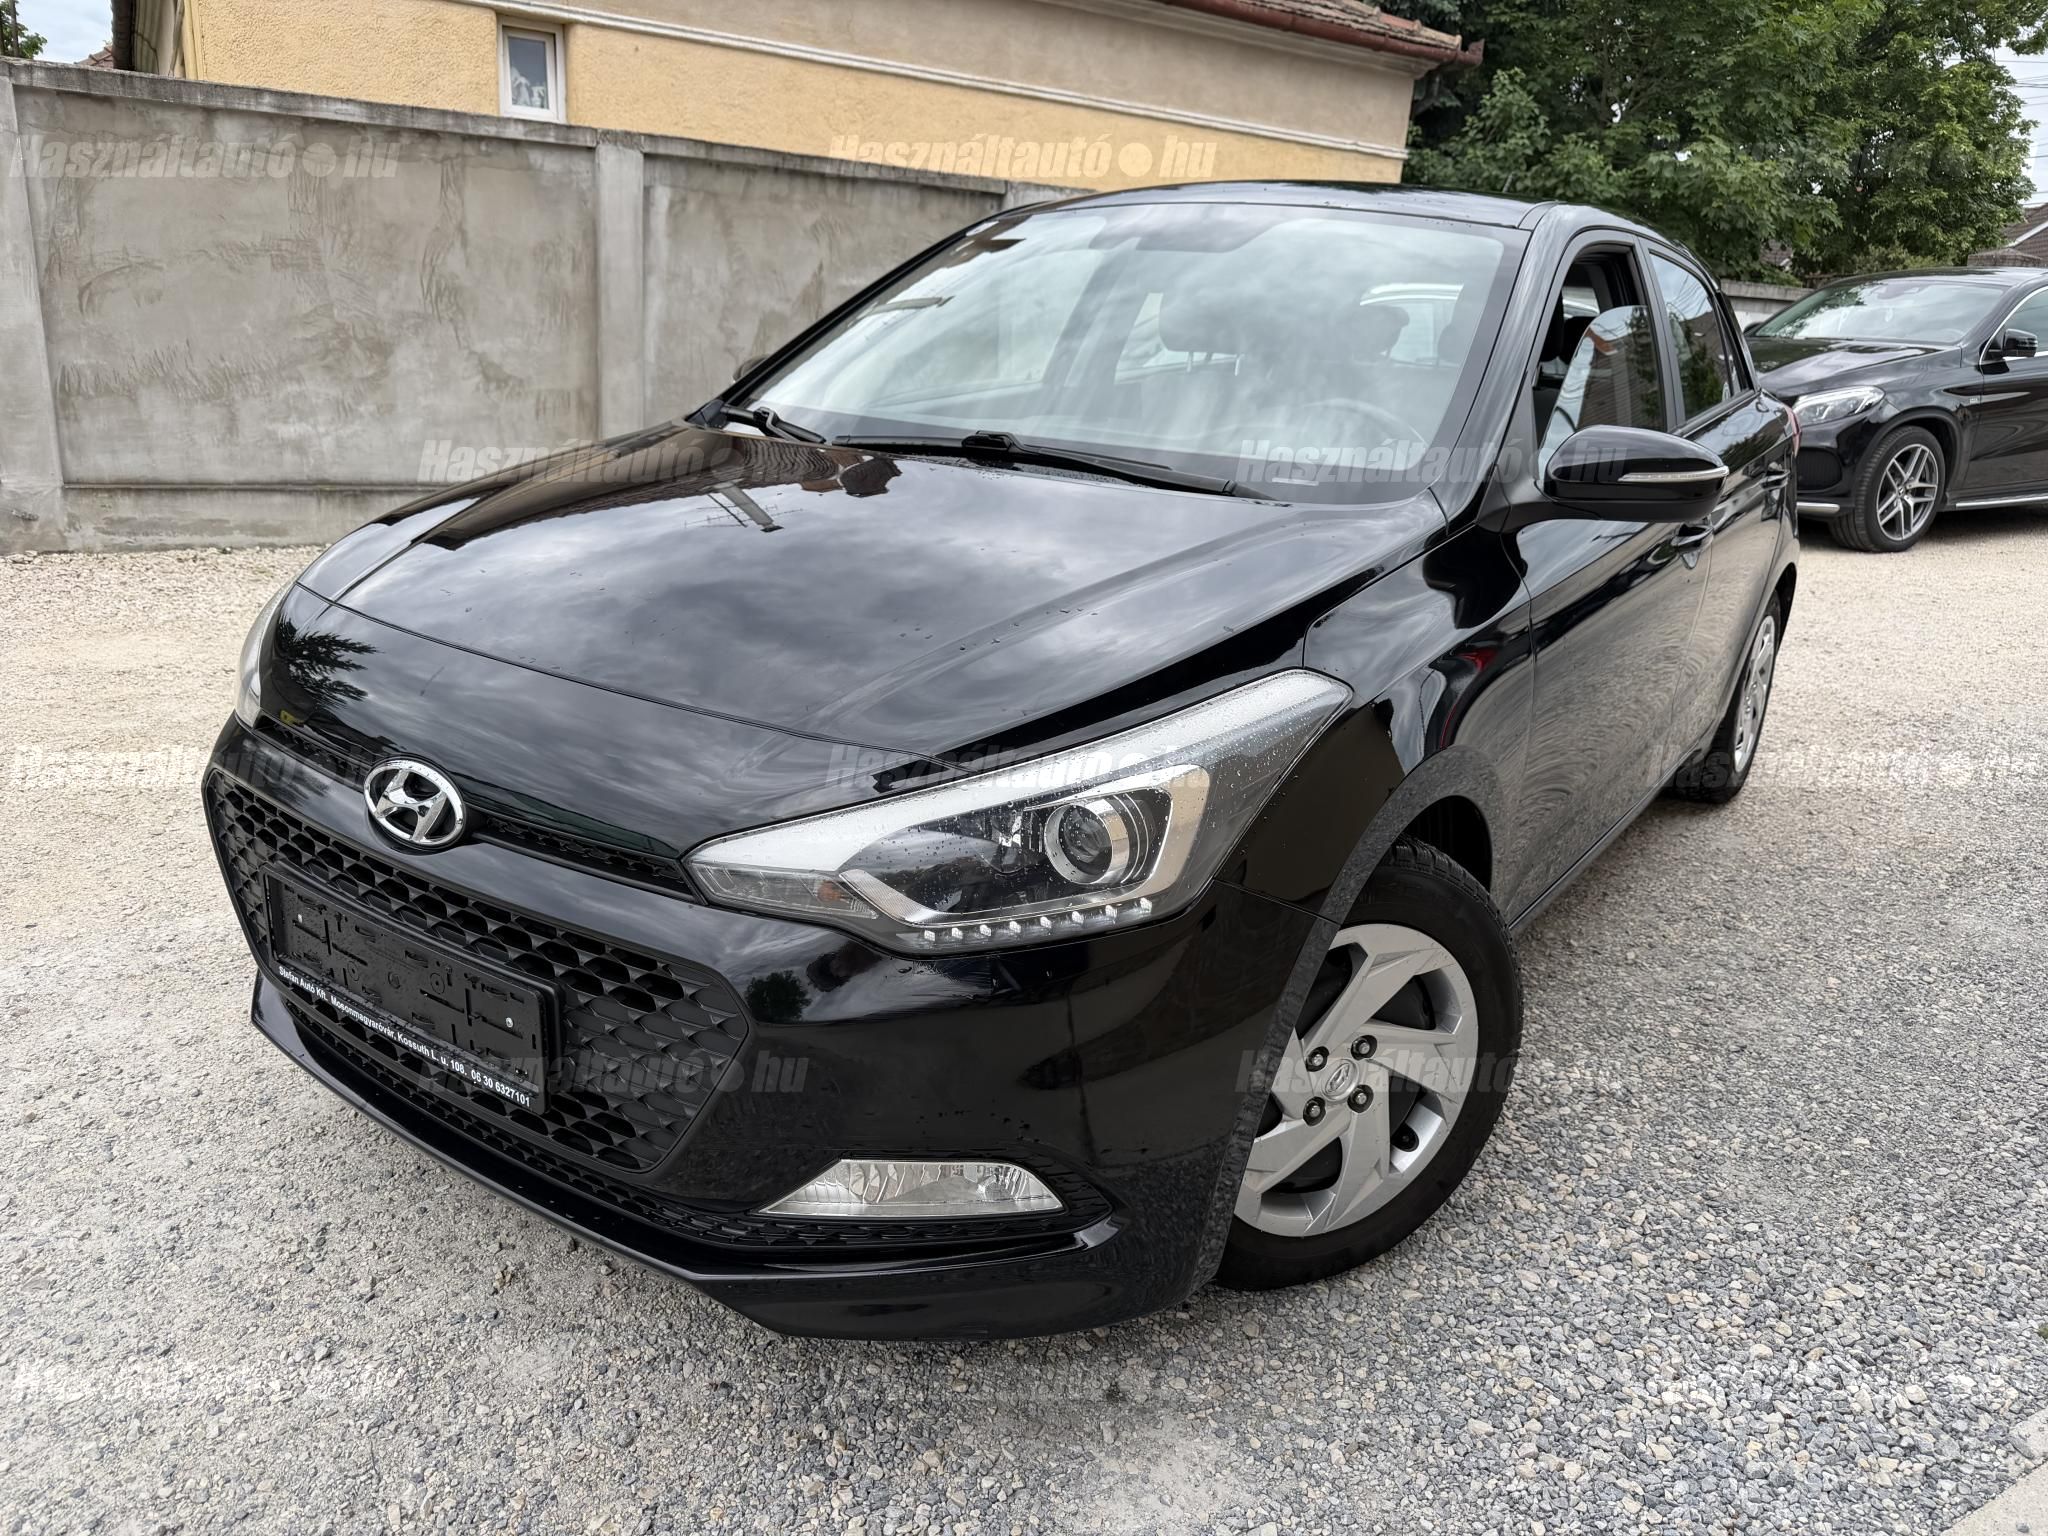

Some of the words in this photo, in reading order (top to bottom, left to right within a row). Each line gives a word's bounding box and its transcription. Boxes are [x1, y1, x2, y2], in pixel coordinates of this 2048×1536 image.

[279, 966, 299, 984] Stefan
[300, 979, 316, 994] Autó
[397, 1031, 430, 1056] Kossuth
[430, 1049, 440, 1061] L.
[440, 1056, 449, 1066] u.
[450, 1060, 468, 1076] 108.
[471, 1069, 482, 1082] 06
[483, 1075, 494, 1088] 30
[495, 1082, 530, 1107] 6327101
